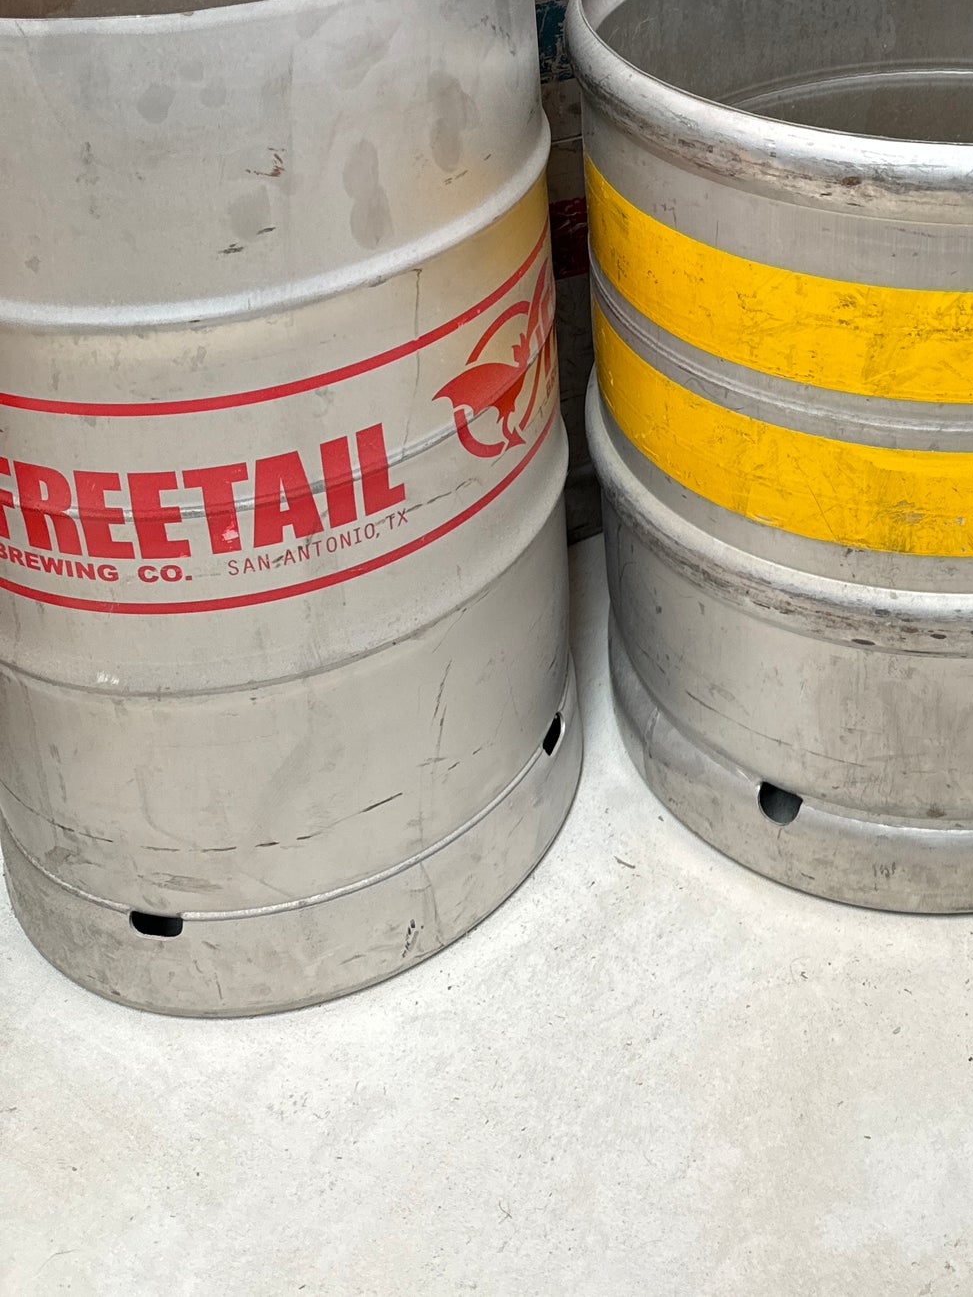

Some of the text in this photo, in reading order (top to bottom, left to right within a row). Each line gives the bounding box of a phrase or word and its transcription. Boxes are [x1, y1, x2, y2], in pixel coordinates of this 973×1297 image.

[227, 508, 408, 577] SAN ANTONIO, TX
[138, 564, 193, 583] CO.
